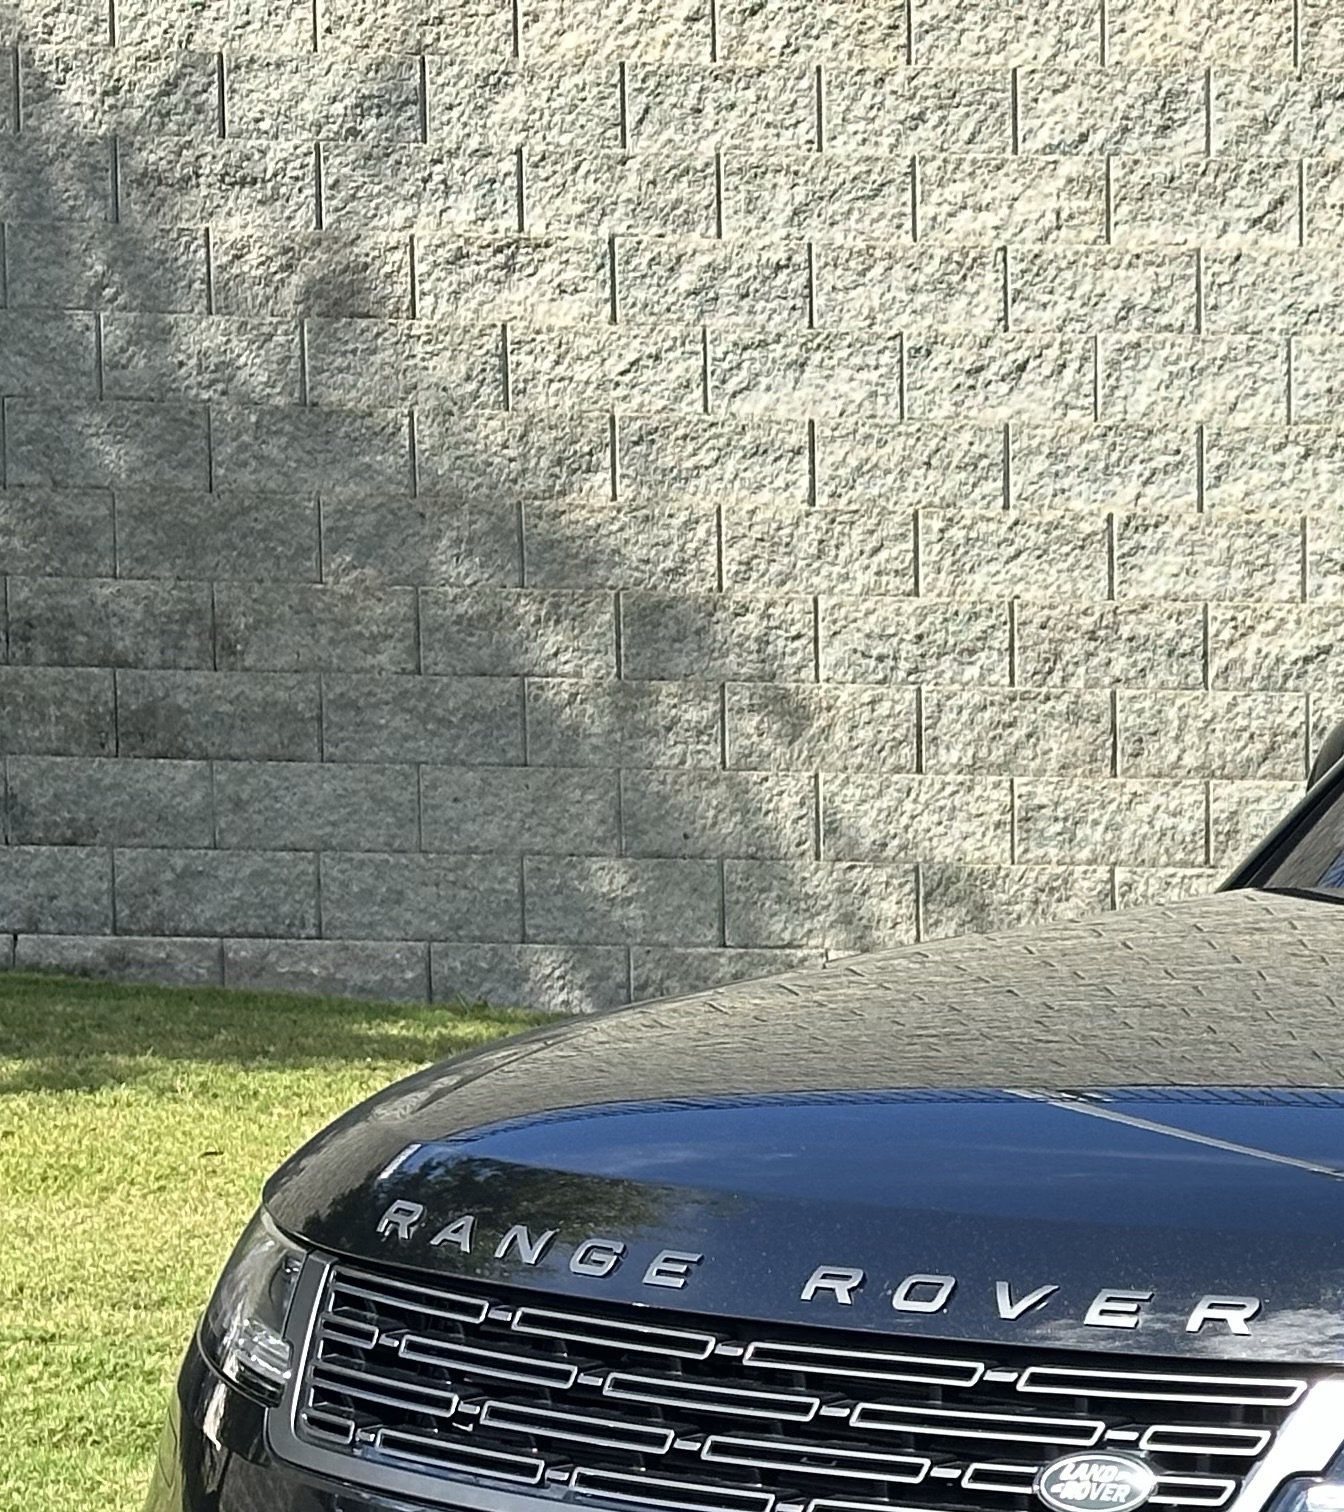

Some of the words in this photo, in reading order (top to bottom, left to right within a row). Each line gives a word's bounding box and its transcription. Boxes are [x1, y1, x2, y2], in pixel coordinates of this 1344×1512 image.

[376, 1198, 706, 1291] RANGE
[799, 1264, 1264, 1338] ROVER
[1059, 1462, 1119, 1483] LAND
[1059, 1480, 1132, 1503] ROVER
